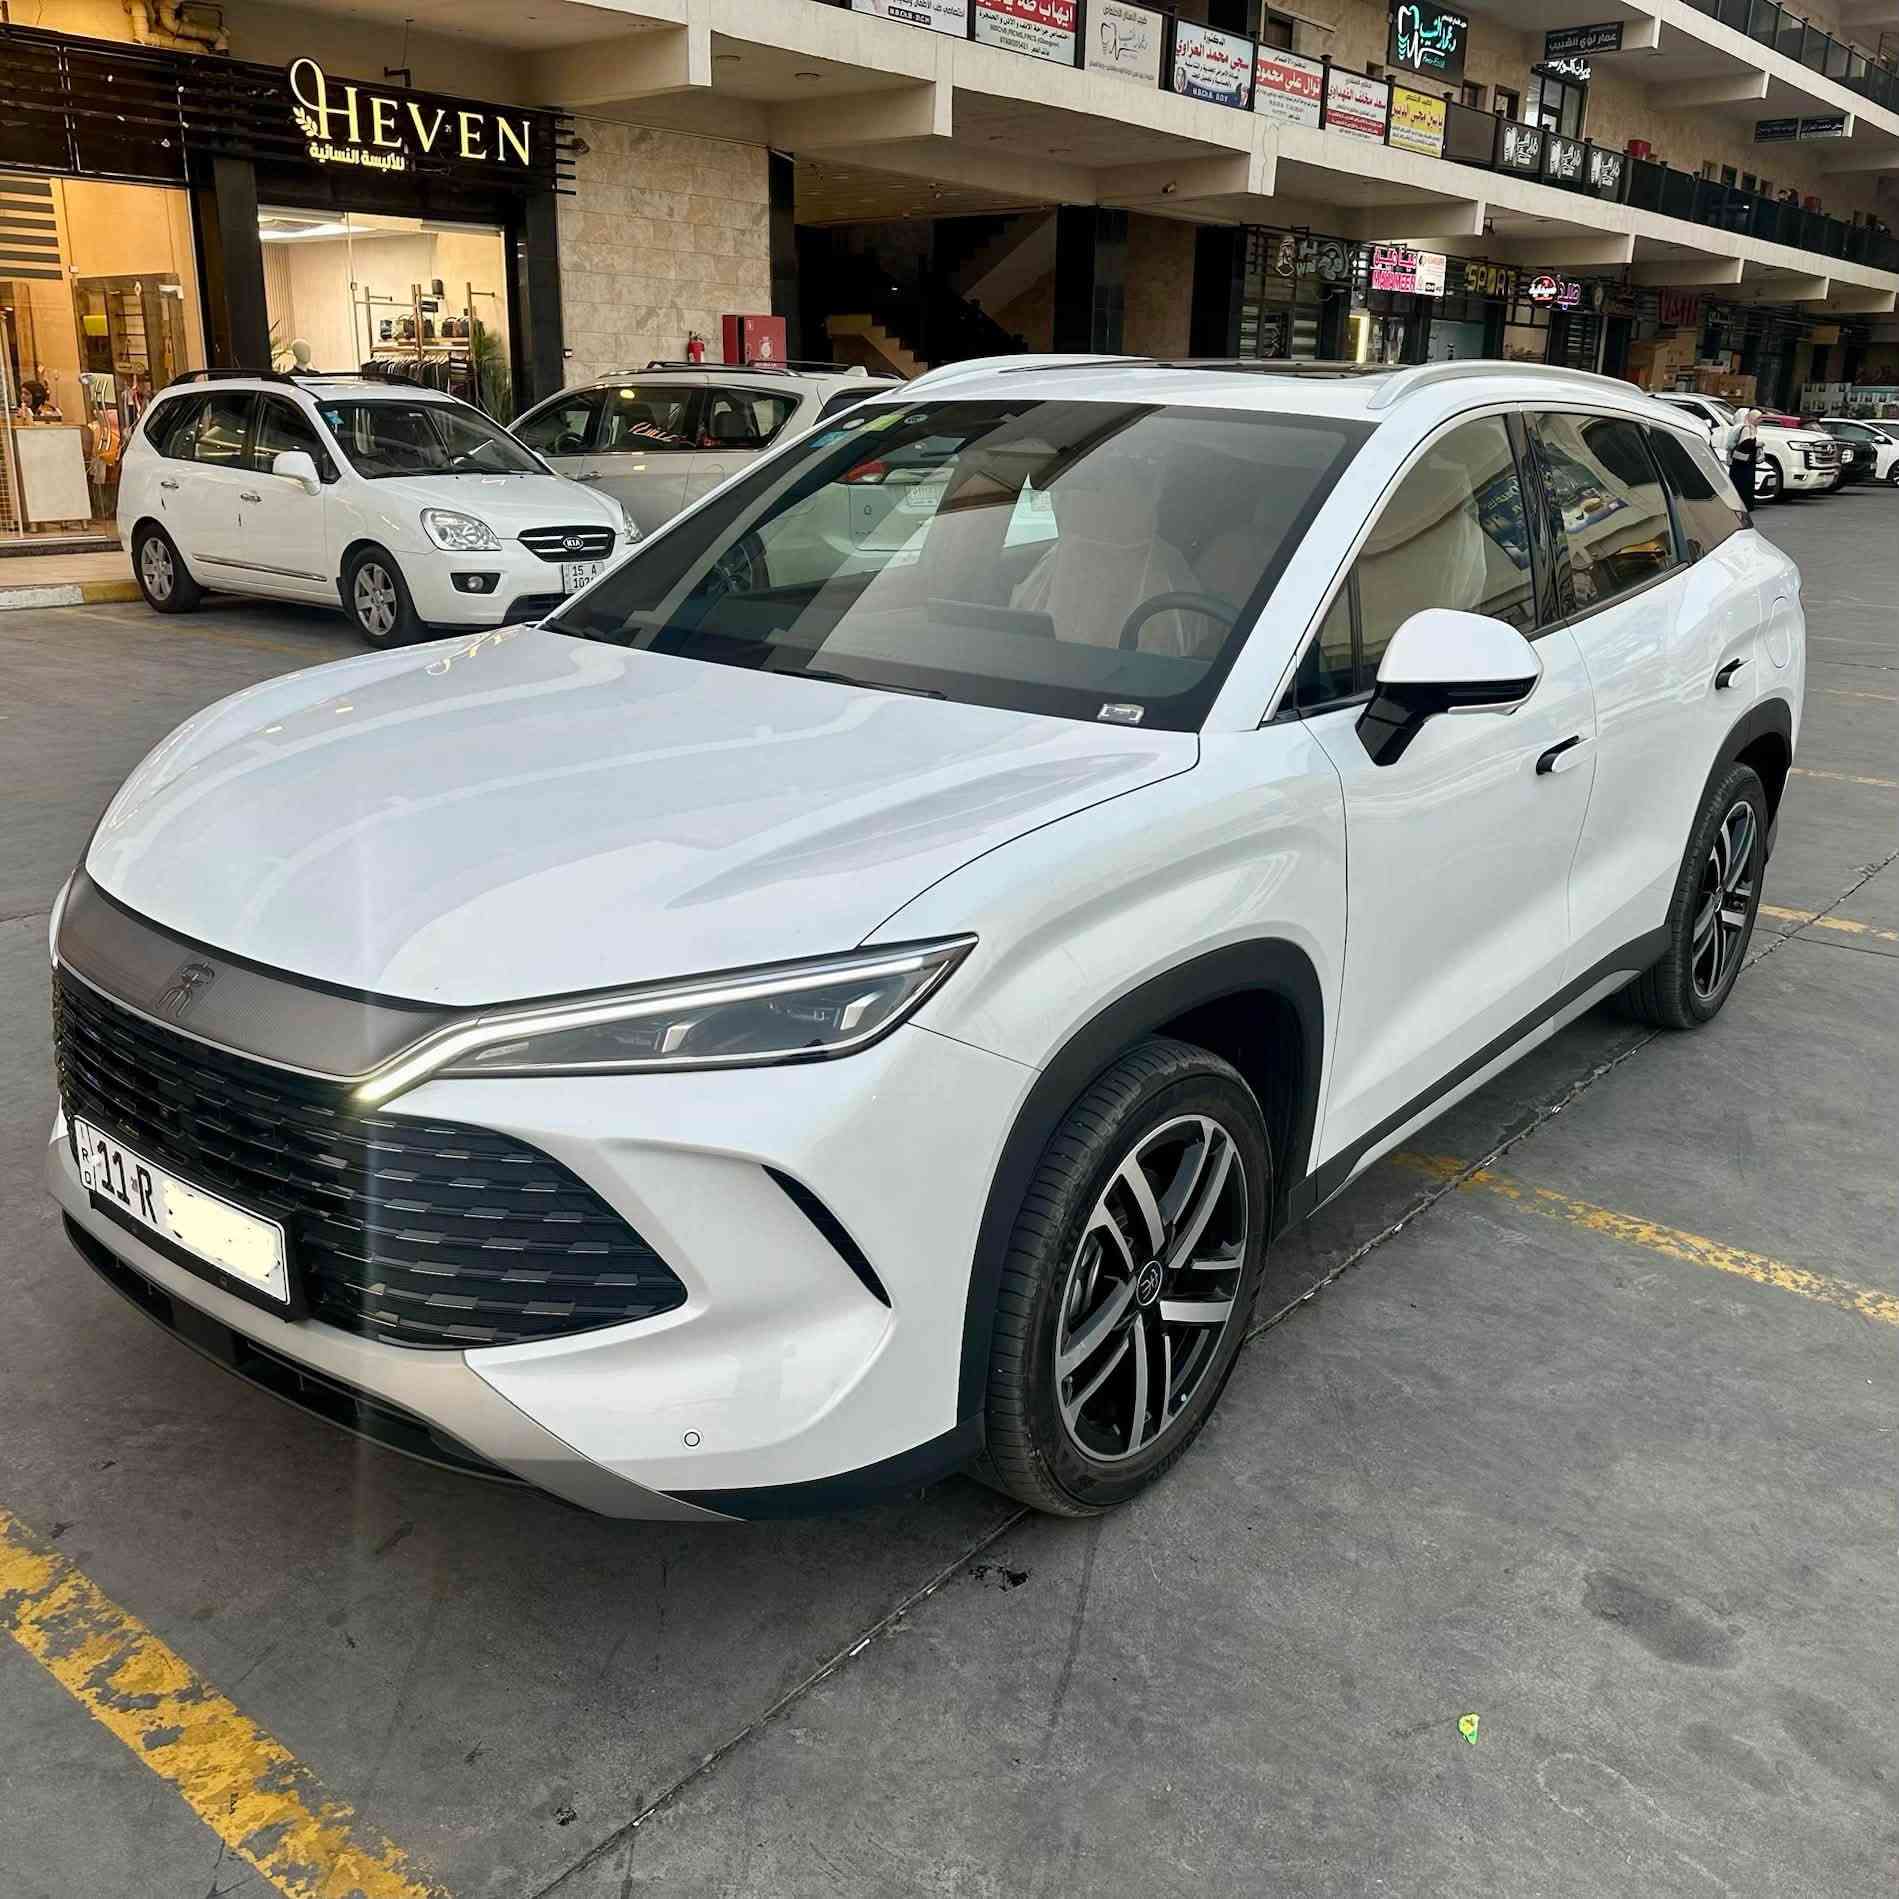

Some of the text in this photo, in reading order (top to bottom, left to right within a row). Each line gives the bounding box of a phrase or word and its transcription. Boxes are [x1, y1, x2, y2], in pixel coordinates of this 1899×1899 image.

[289, 57, 531, 167] HEVEN
[566, 539, 581, 547] KIA
[572, 564, 597, 577] 15 A
[573, 577, 595, 589] 102
[97, 1139, 159, 1225] 11 R
